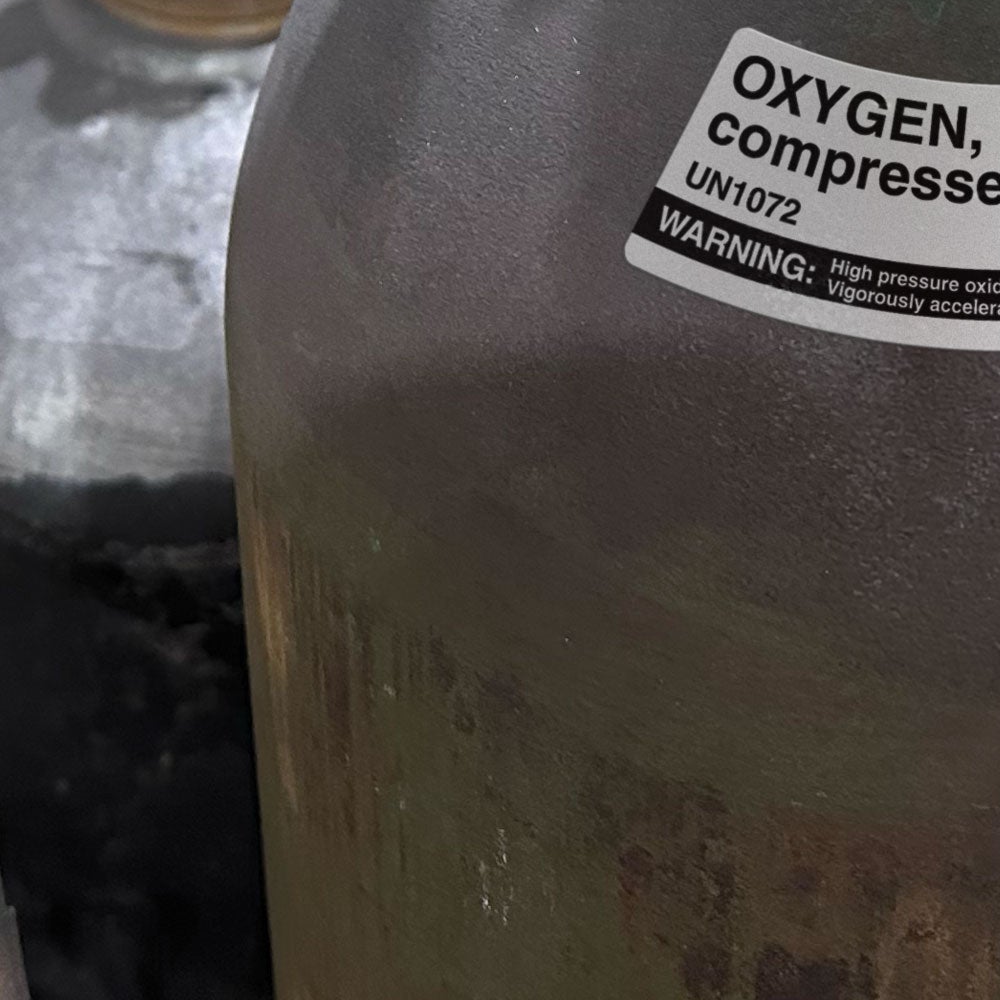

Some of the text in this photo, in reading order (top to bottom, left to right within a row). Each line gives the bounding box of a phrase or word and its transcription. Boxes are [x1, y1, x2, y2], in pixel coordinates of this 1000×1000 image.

[733, 55, 982, 159] OXYGEN,
[685, 161, 802, 225] UN1072
[658, 205, 816, 283] WARNING:
[830, 258, 872, 281] High
[877, 270, 960, 291] pressure
[827, 279, 925, 314] Vigorously
